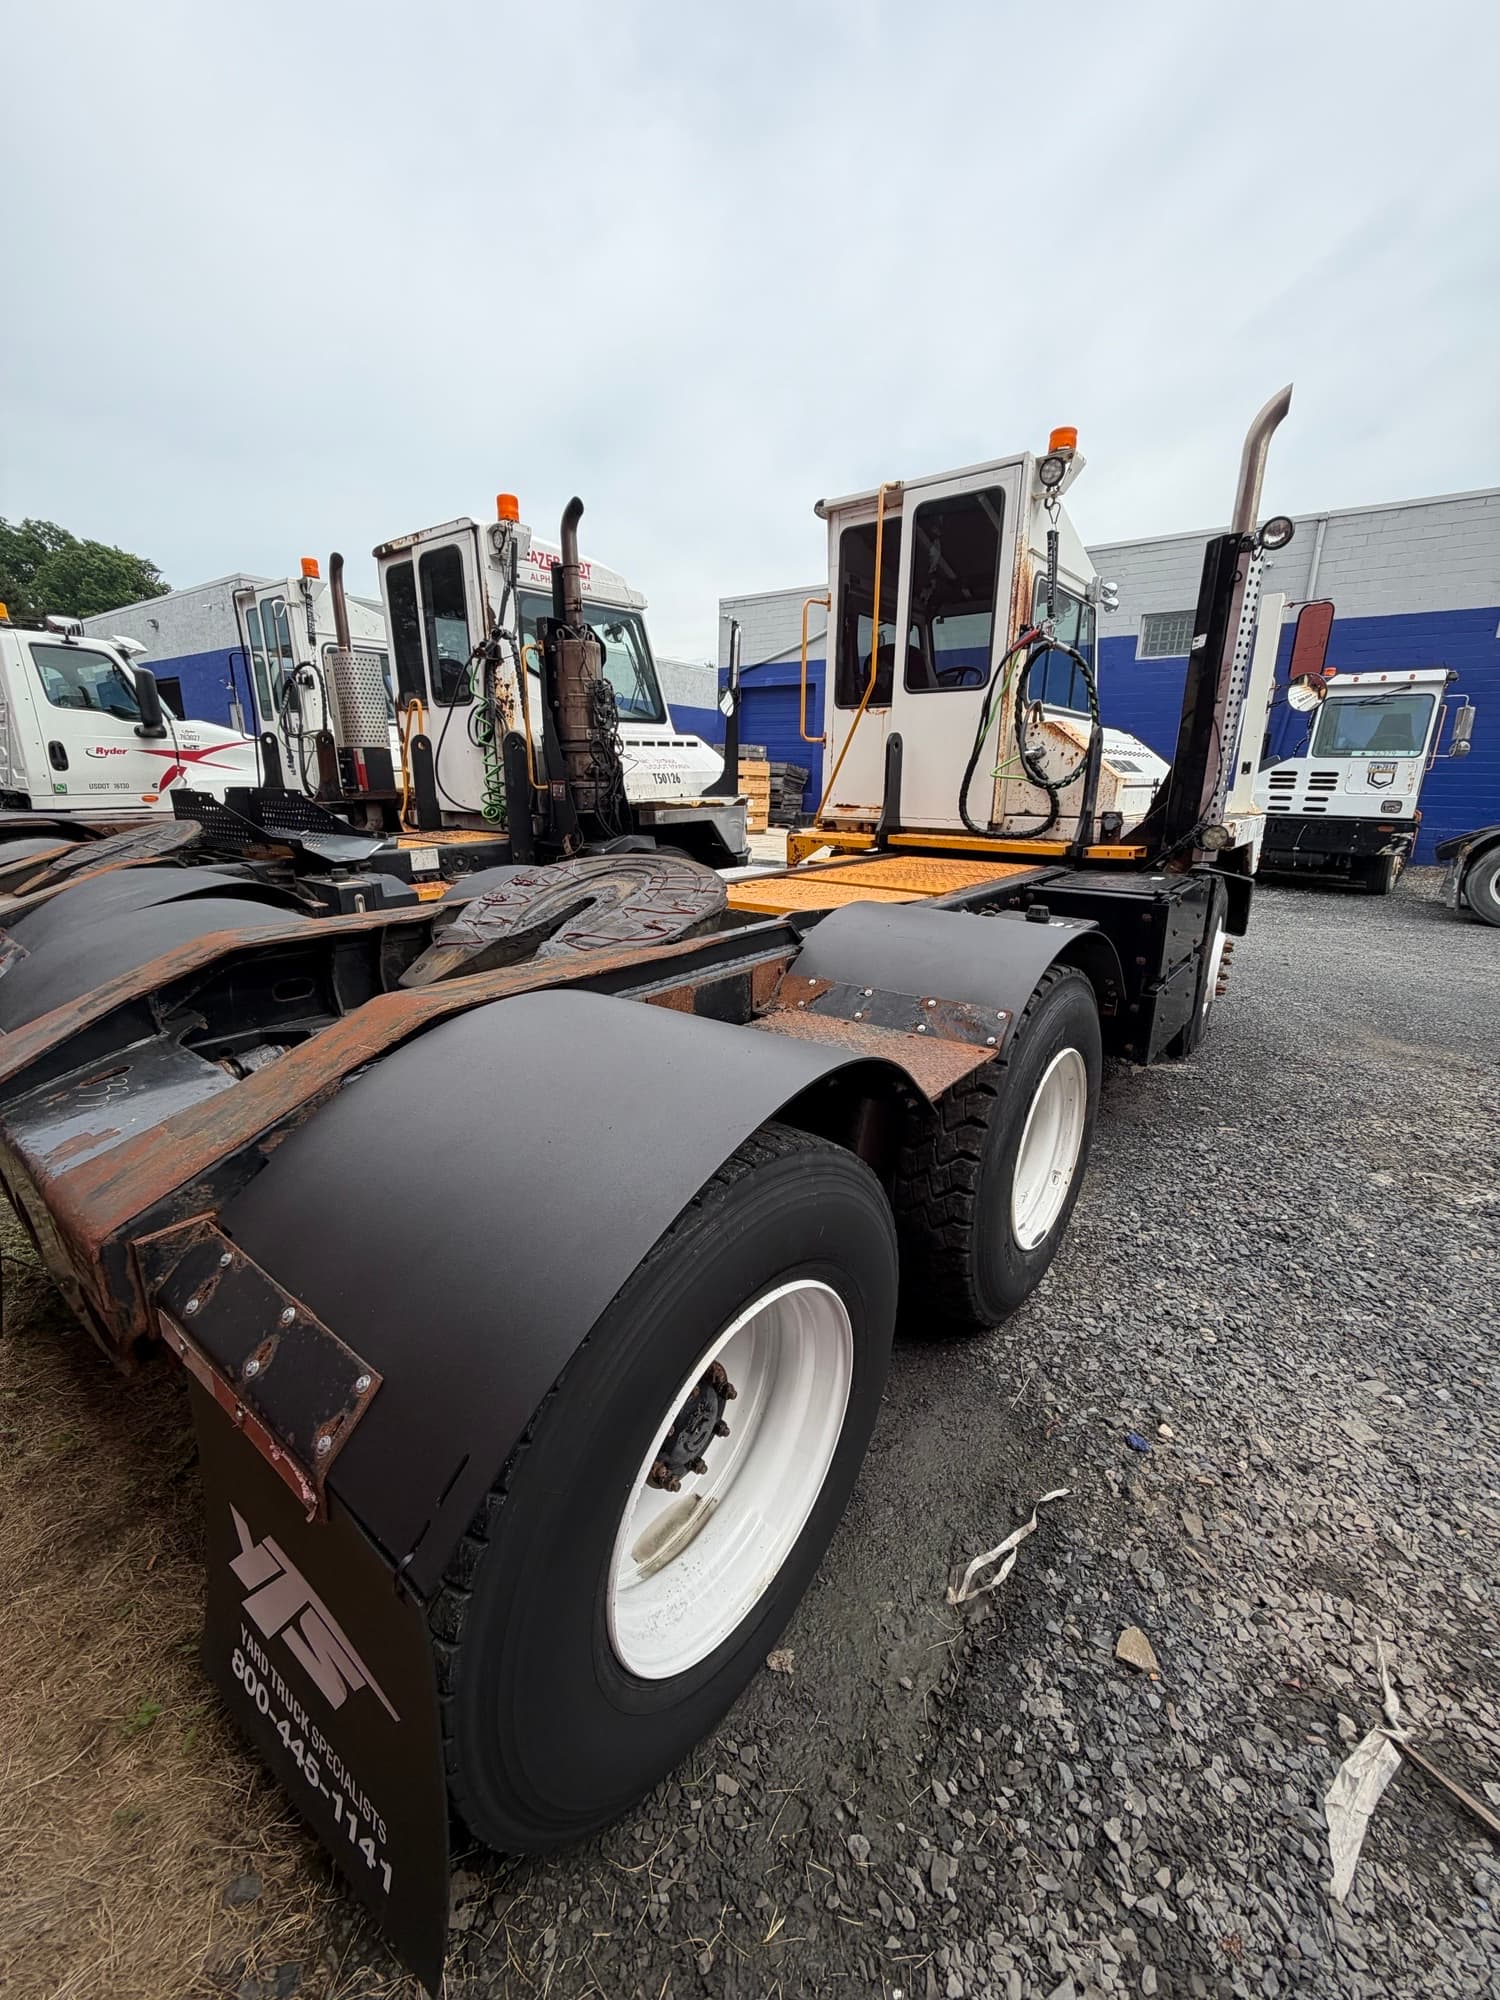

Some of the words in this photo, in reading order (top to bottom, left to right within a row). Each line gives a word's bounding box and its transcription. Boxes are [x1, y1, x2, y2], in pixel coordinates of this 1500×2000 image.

[95, 747, 128, 756] Ryder
[652, 773, 681, 784] T50126
[228, 1501, 400, 1722] YTS
[232, 1648, 392, 1895] 800-445-1141
[240, 1622, 269, 1676] YARD
[270, 1665, 310, 1738] TRUCK
[311, 1725, 387, 1845] SPECIALISTS
